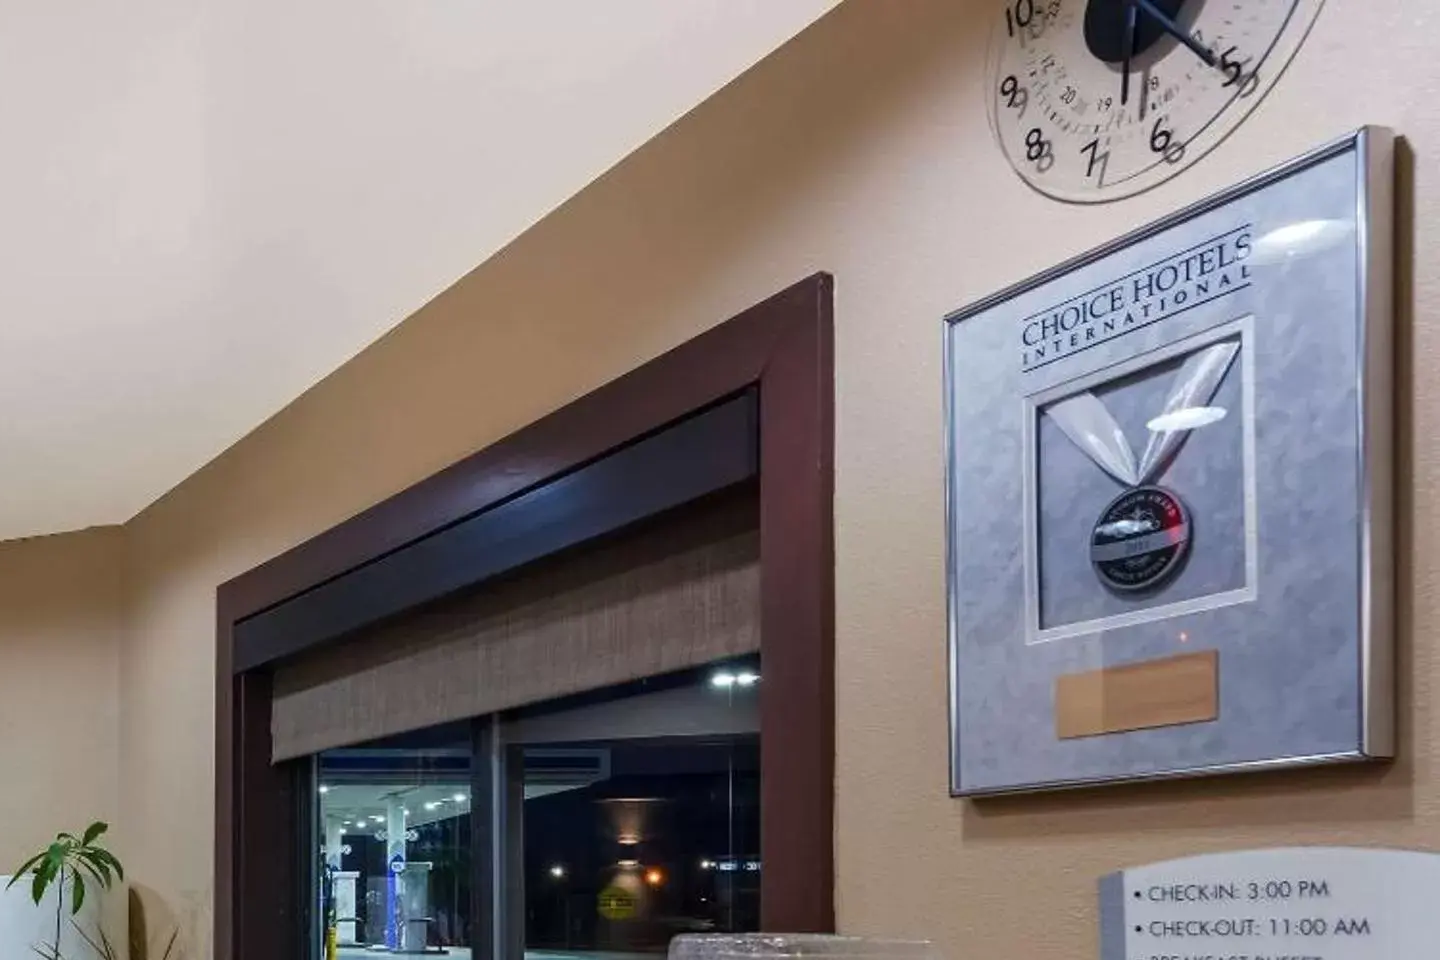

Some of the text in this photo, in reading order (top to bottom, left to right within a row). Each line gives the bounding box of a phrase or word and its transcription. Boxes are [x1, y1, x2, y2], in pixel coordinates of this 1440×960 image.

[1005, 0, 1033, 37] 10
[1220, 46, 1240, 88] 5
[1000, 75, 1018, 108] 9
[1024, 128, 1043, 162] 8
[1150, 117, 1171, 153] 6
[1080, 138, 1099, 178] 7
[1021, 233, 1252, 347] CHOICE HOTELS
[1022, 264, 1252, 366] INTERNATIONAL
[1247, 881, 1292, 901] 3:00
[1298, 880, 1330, 898] PM
[1269, 918, 1327, 937] 11:00
[1334, 918, 1371, 936] AM
